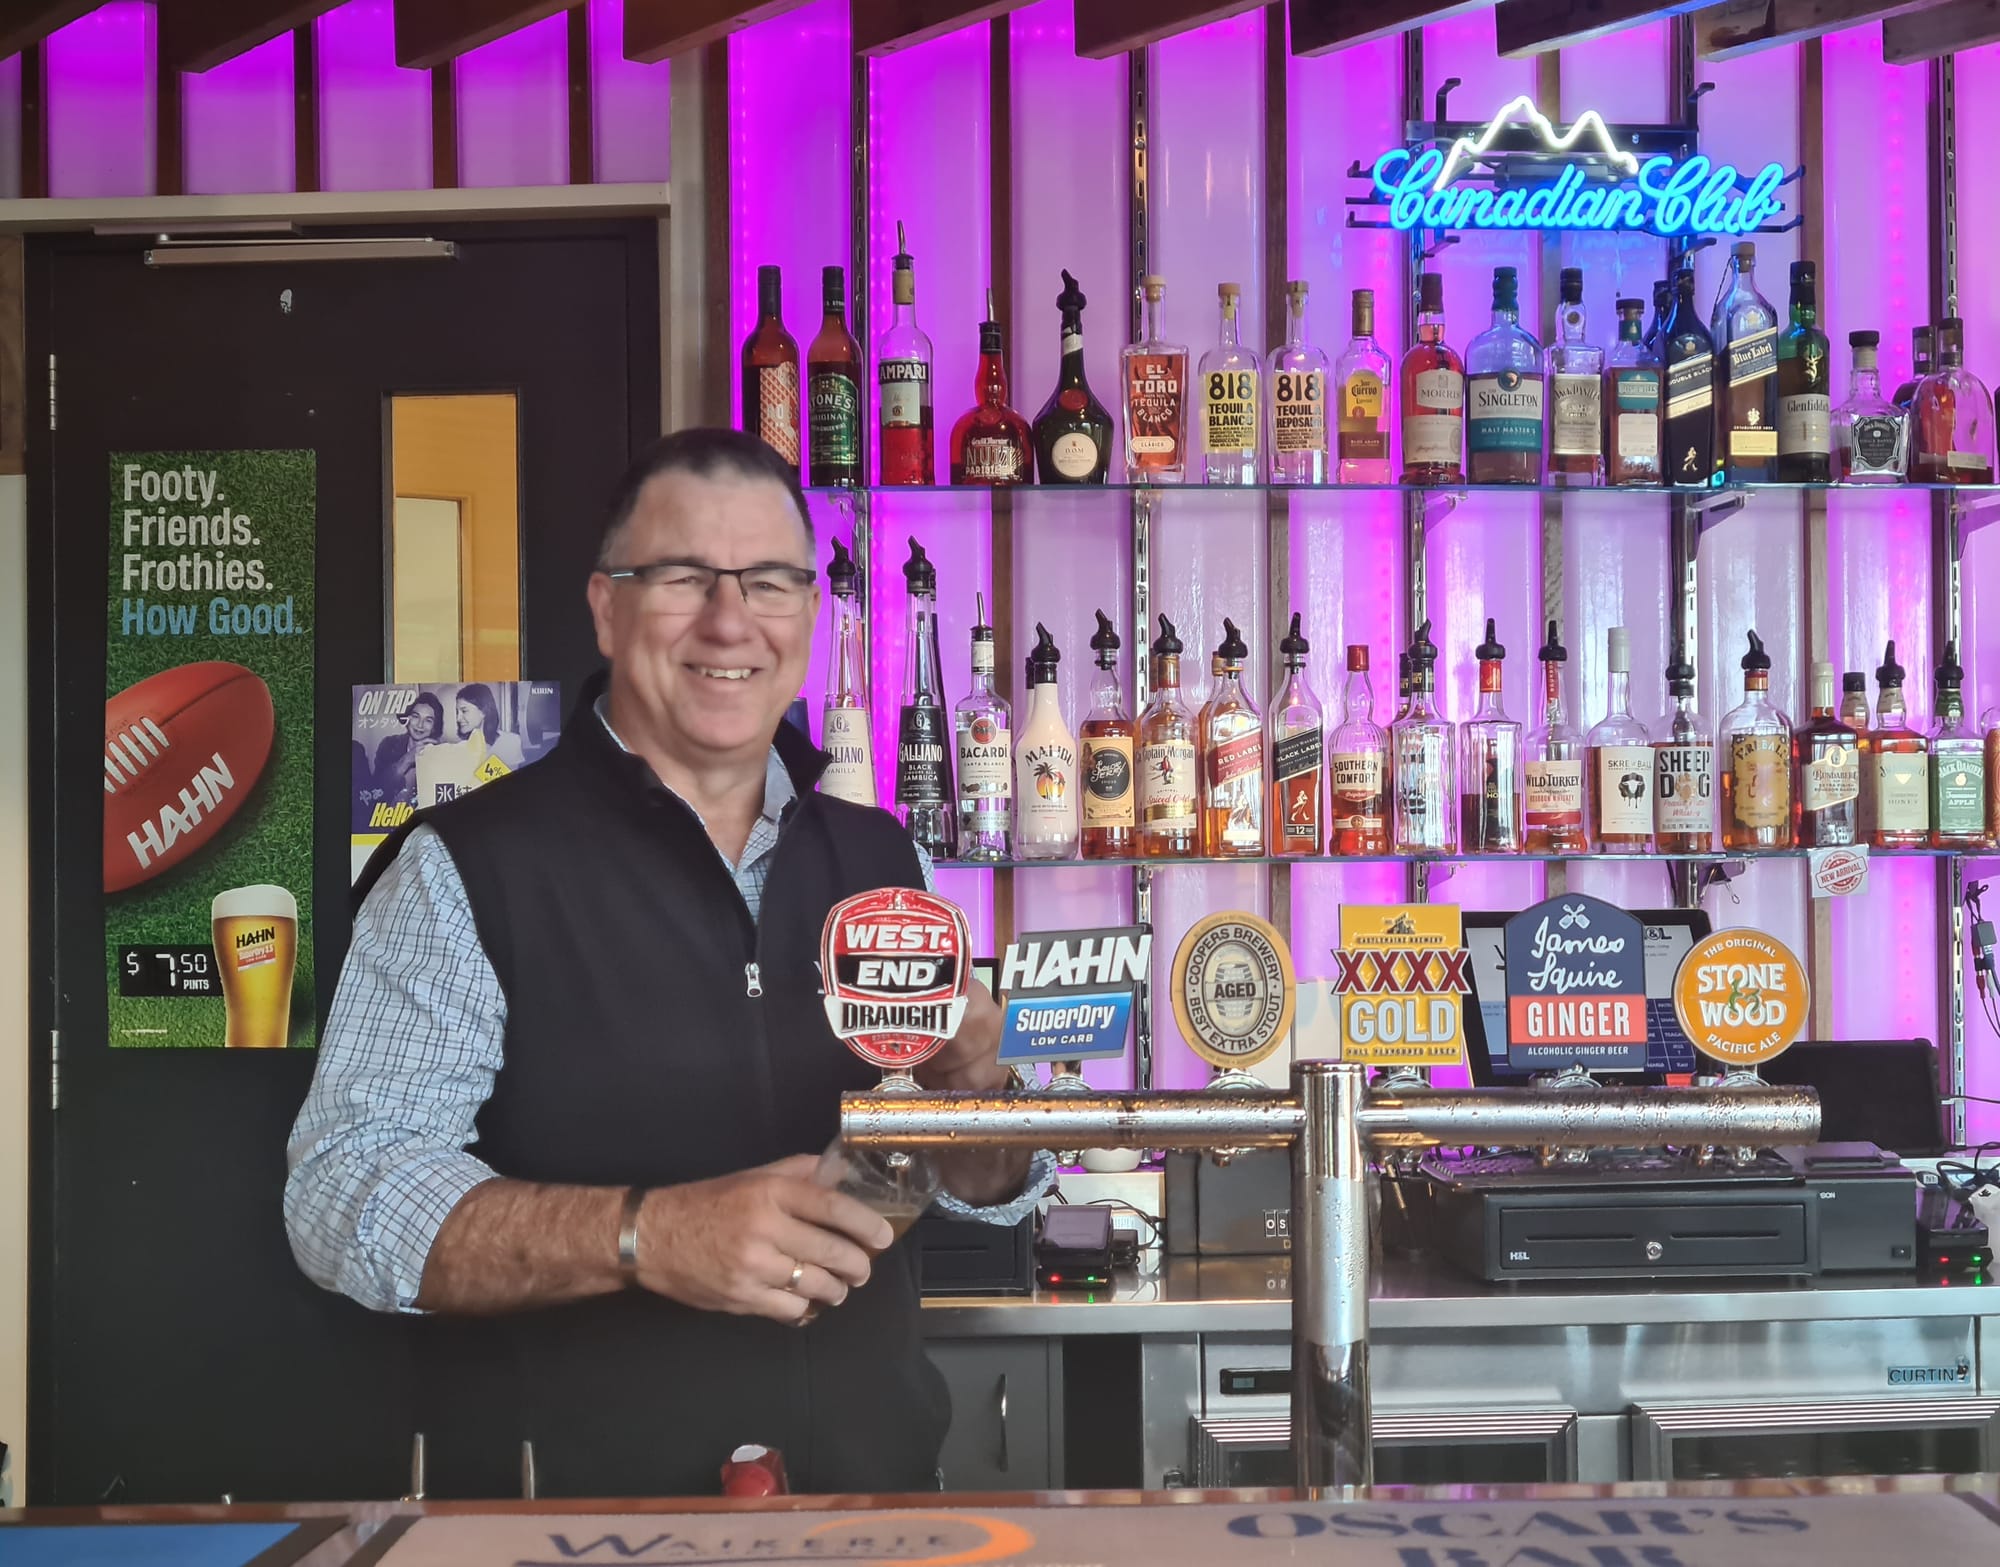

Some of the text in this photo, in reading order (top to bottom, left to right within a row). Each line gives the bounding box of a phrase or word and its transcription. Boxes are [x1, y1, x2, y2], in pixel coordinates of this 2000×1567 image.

[1372, 148, 1786, 233] Canadian Club
[1732, 343, 1774, 366] Blue Label
[880, 363, 927, 379] AMPARI
[1146, 364, 1165, 374] EL
[1132, 380, 1178, 393] TORO
[1209, 372, 1253, 400] 818
[1277, 374, 1320, 402] 818
[1351, 384, 1378, 396] Cuervo
[1420, 388, 1460, 399] MORRIS
[809, 393, 852, 410] TONE'S
[1134, 398, 1176, 407] TEQUILA
[1208, 403, 1253, 414] TEQUILA
[1276, 405, 1321, 416] TEQUILA
[1478, 391, 1538, 408] SINGLETON
[1136, 407, 1173, 424] BLANCO
[1208, 415, 1253, 427] BLANCO
[123, 463, 225, 508] Footy.
[123, 506, 261, 546] Friends.
[122, 551, 273, 591] Frothies.
[122, 595, 303, 635] How Good.
[358, 689, 417, 715] ON TAP
[531, 687, 554, 695] KIRIN
[358, 716, 410, 729] オンタップ
[824, 746, 864, 764] LLIANO
[899, 742, 943, 763] GALLIANO
[960, 743, 1008, 759] BACARDÍ
[1217, 743, 1262, 766] RED LABEL
[1659, 750, 1710, 772] SHEEP
[1735, 739, 1787, 761] FIRBALL
[1334, 760, 1379, 773] SOUTHERN
[1939, 764, 1956, 778] JACK
[1336, 772, 1376, 784] COMFORT
[1525, 773, 1580, 788] WILD TURKEY
[126, 751, 235, 870] HAHN
[369, 802, 414, 827] Hello
[1295, 826, 1306, 836] 12
[1820, 862, 1862, 884] NEW ARRIVAL
[236, 926, 275, 948] HAHN
[844, 924, 949, 949] WEST
[1409, 936, 1444, 944] BREWERY
[1530, 915, 1625, 959] James
[1644, 927, 1673, 940] &L
[1188, 927, 1281, 986] COOPERS BREWERY
[1703, 938, 1777, 960] THE ORIGINAL
[126, 952, 208, 987] $ 7.50
[1000, 934, 1153, 990] HAHN
[1331, 949, 1472, 994] XXXX
[183, 979, 210, 990] PINTS
[856, 960, 938, 987] END
[1527, 952, 1623, 995] Squire
[1696, 963, 1787, 994] STONE
[1214, 982, 1257, 999] AGED
[840, 1001, 953, 1034] DRAUGHT
[1015, 1004, 1116, 1032] SuperDry
[1189, 992, 1281, 1051] BEST EXTRA STOUT
[1349, 1000, 1456, 1044] GOLD
[1527, 1002, 1631, 1038] GINGER
[1699, 1000, 1788, 1028] WOOD
[1030, 1033, 1094, 1047] LOW CARB
[1527, 1046, 1629, 1056] ALCOHOLIC GINGER BEER
[1706, 1032, 1757, 1055] PACIFIC
[1759, 1031, 1783, 1051] ALE
[1889, 1368, 1955, 1382] CURTIN
[1226, 1509, 1810, 1539] OSCAR'S
[547, 1532, 950, 1560] WAIKERIE
[1396, 1544, 1690, 1567] BAR
